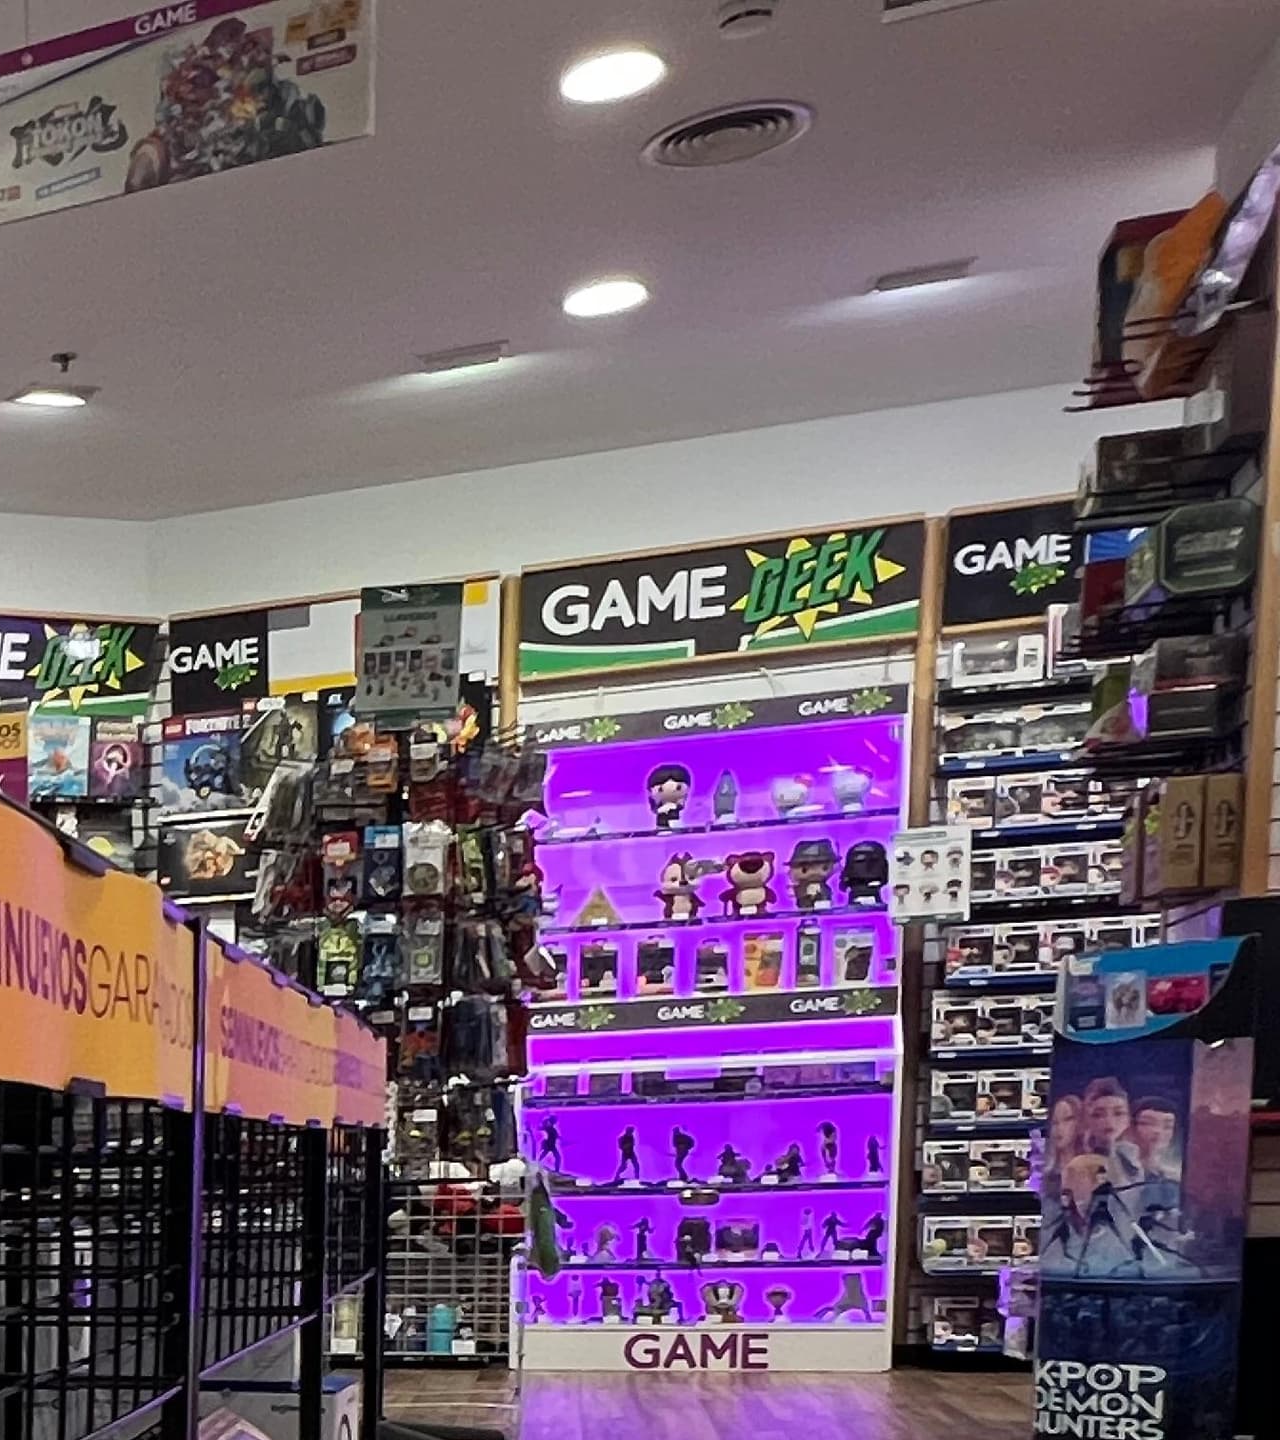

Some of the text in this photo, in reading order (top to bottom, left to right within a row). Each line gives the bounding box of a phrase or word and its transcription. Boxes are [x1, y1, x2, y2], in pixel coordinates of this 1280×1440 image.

[135, 3, 197, 35] GAME
[954, 534, 1072, 576] GAME
[541, 528, 887, 636] GAME GEEK
[169, 637, 260, 674] GAME
[798, 698, 850, 716] GAME
[664, 711, 713, 731] GAME
[536, 727, 581, 744] GAME
[657, 1004, 705, 1021] GAME
[790, 997, 841, 1014] GAME
[530, 1012, 577, 1029] GAME
[623, 1333, 770, 1370] GAME
[1035, 1389, 1165, 1420] DEMON
